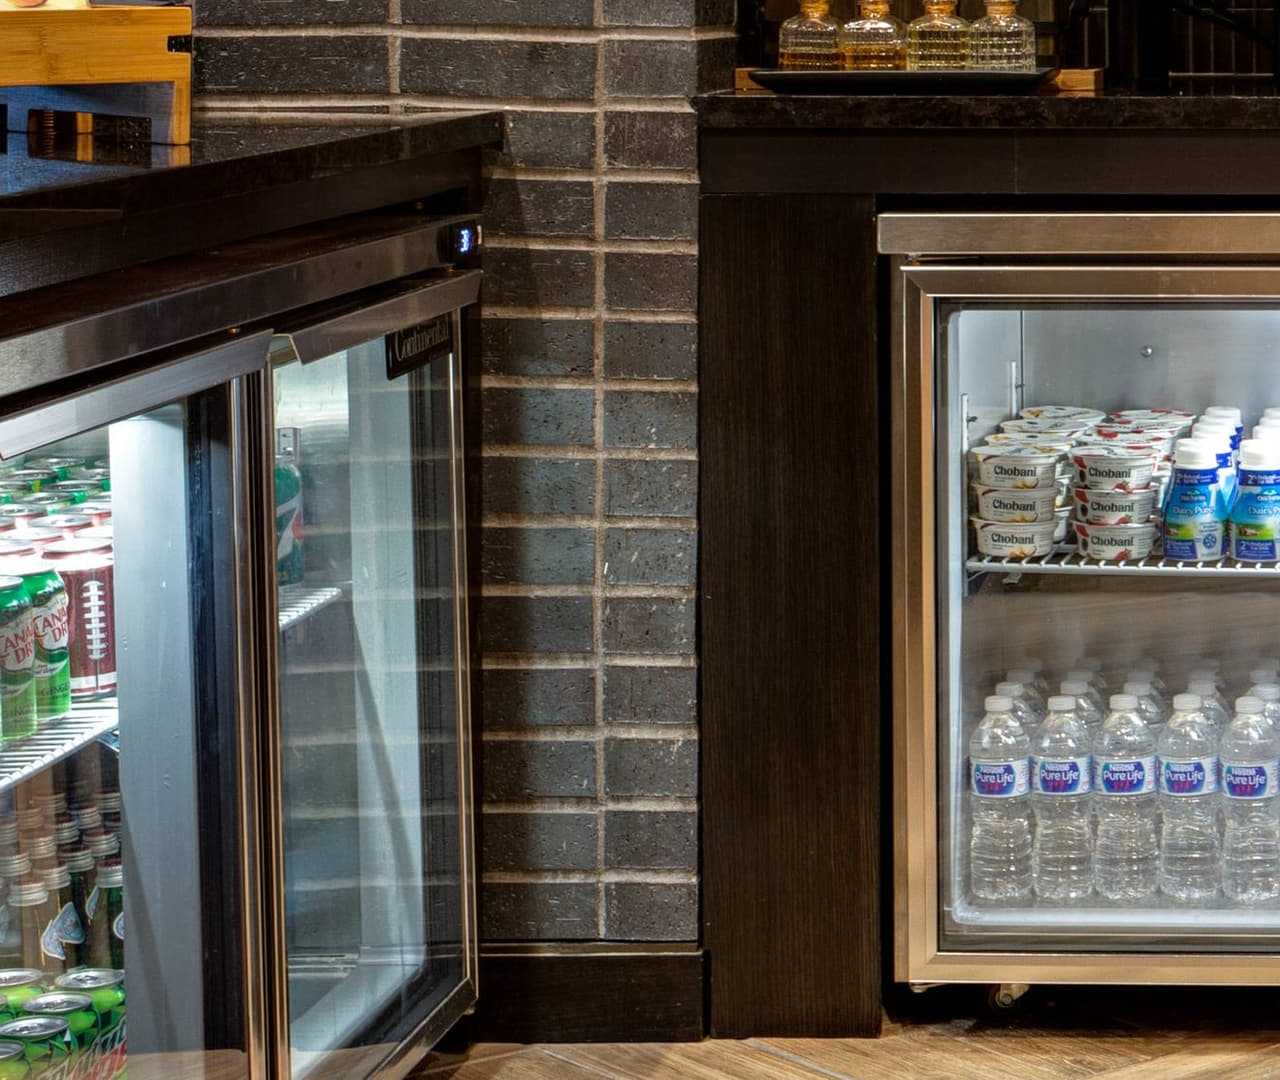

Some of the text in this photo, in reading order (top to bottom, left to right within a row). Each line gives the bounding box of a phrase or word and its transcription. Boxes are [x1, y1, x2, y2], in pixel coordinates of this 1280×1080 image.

[994, 465, 1036, 477] Chobani
[1088, 467, 1131, 478] Chobani
[992, 500, 1036, 511] Chobani
[1091, 501, 1134, 512] Chobani
[991, 533, 1035, 544] Chobani
[1091, 535, 1134, 546] Chobani
[976, 773, 996, 783] Pure
[1041, 770, 1060, 780] Pure
[1104, 770, 1126, 780] Pure
[1166, 770, 1186, 780] Pure
[1227, 775, 1248, 784] Pure
